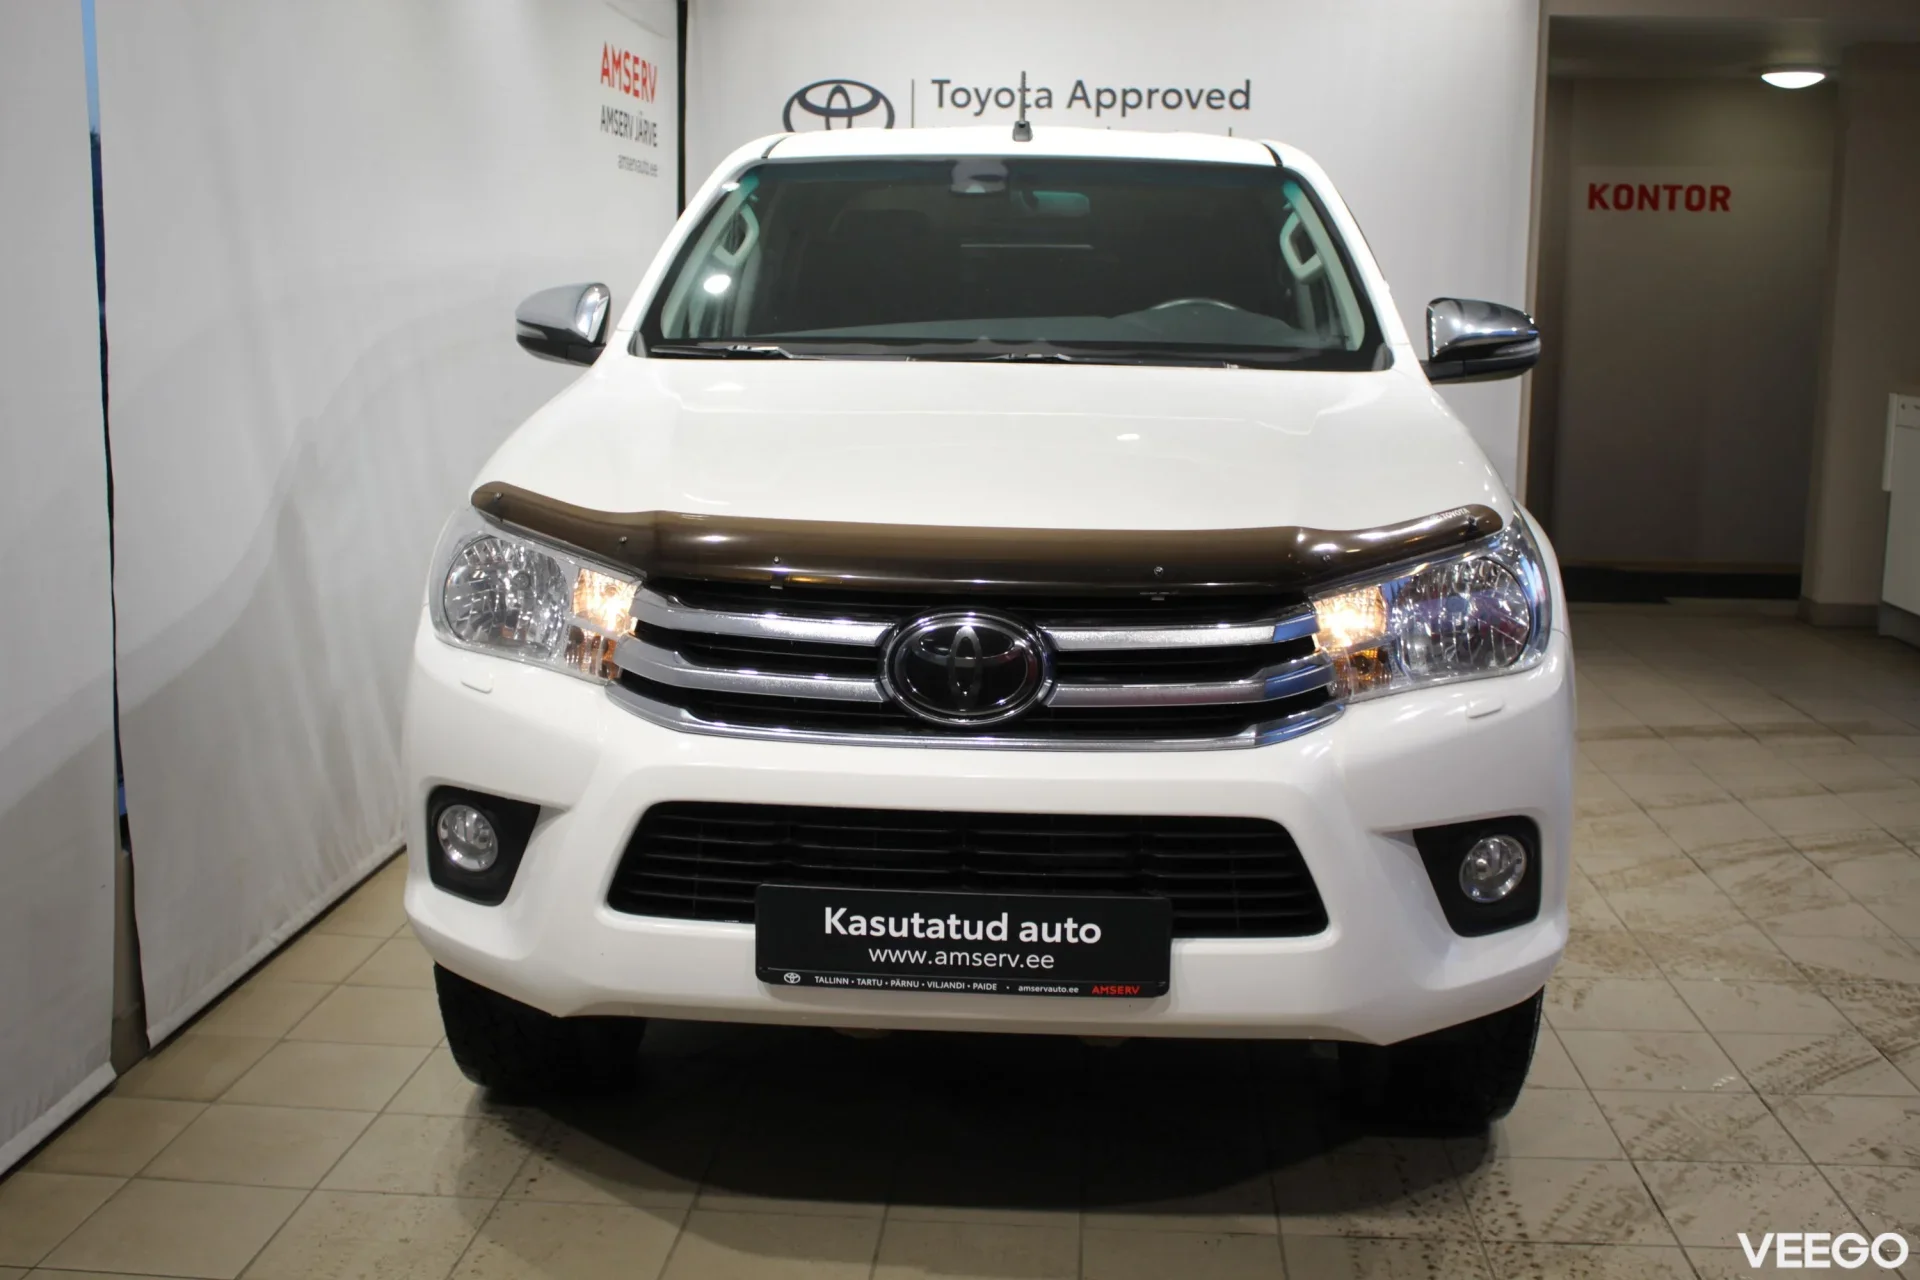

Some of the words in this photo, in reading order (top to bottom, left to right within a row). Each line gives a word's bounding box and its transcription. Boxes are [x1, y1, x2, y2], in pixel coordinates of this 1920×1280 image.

[600, 40, 658, 104] AMSERV
[1067, 79, 1250, 117] Approved
[600, 104, 633, 141] AMSERV
[634, 111, 658, 147] JÄRVE
[1587, 182, 1732, 212] KONTOR
[824, 906, 1009, 942] Kasutatud
[1019, 917, 1102, 944] auto
[868, 947, 1055, 969] www.amserv.ee
[814, 975, 849, 985] TALLINN
[856, 978, 883, 987] TARTU
[890, 979, 920, 988] PÄRNU
[926, 981, 966, 990] VILJANDI
[972, 982, 998, 991] PAIDE
[1018, 984, 1080, 994] amservauto.ee
[1091, 985, 1141, 995] AMSERV
